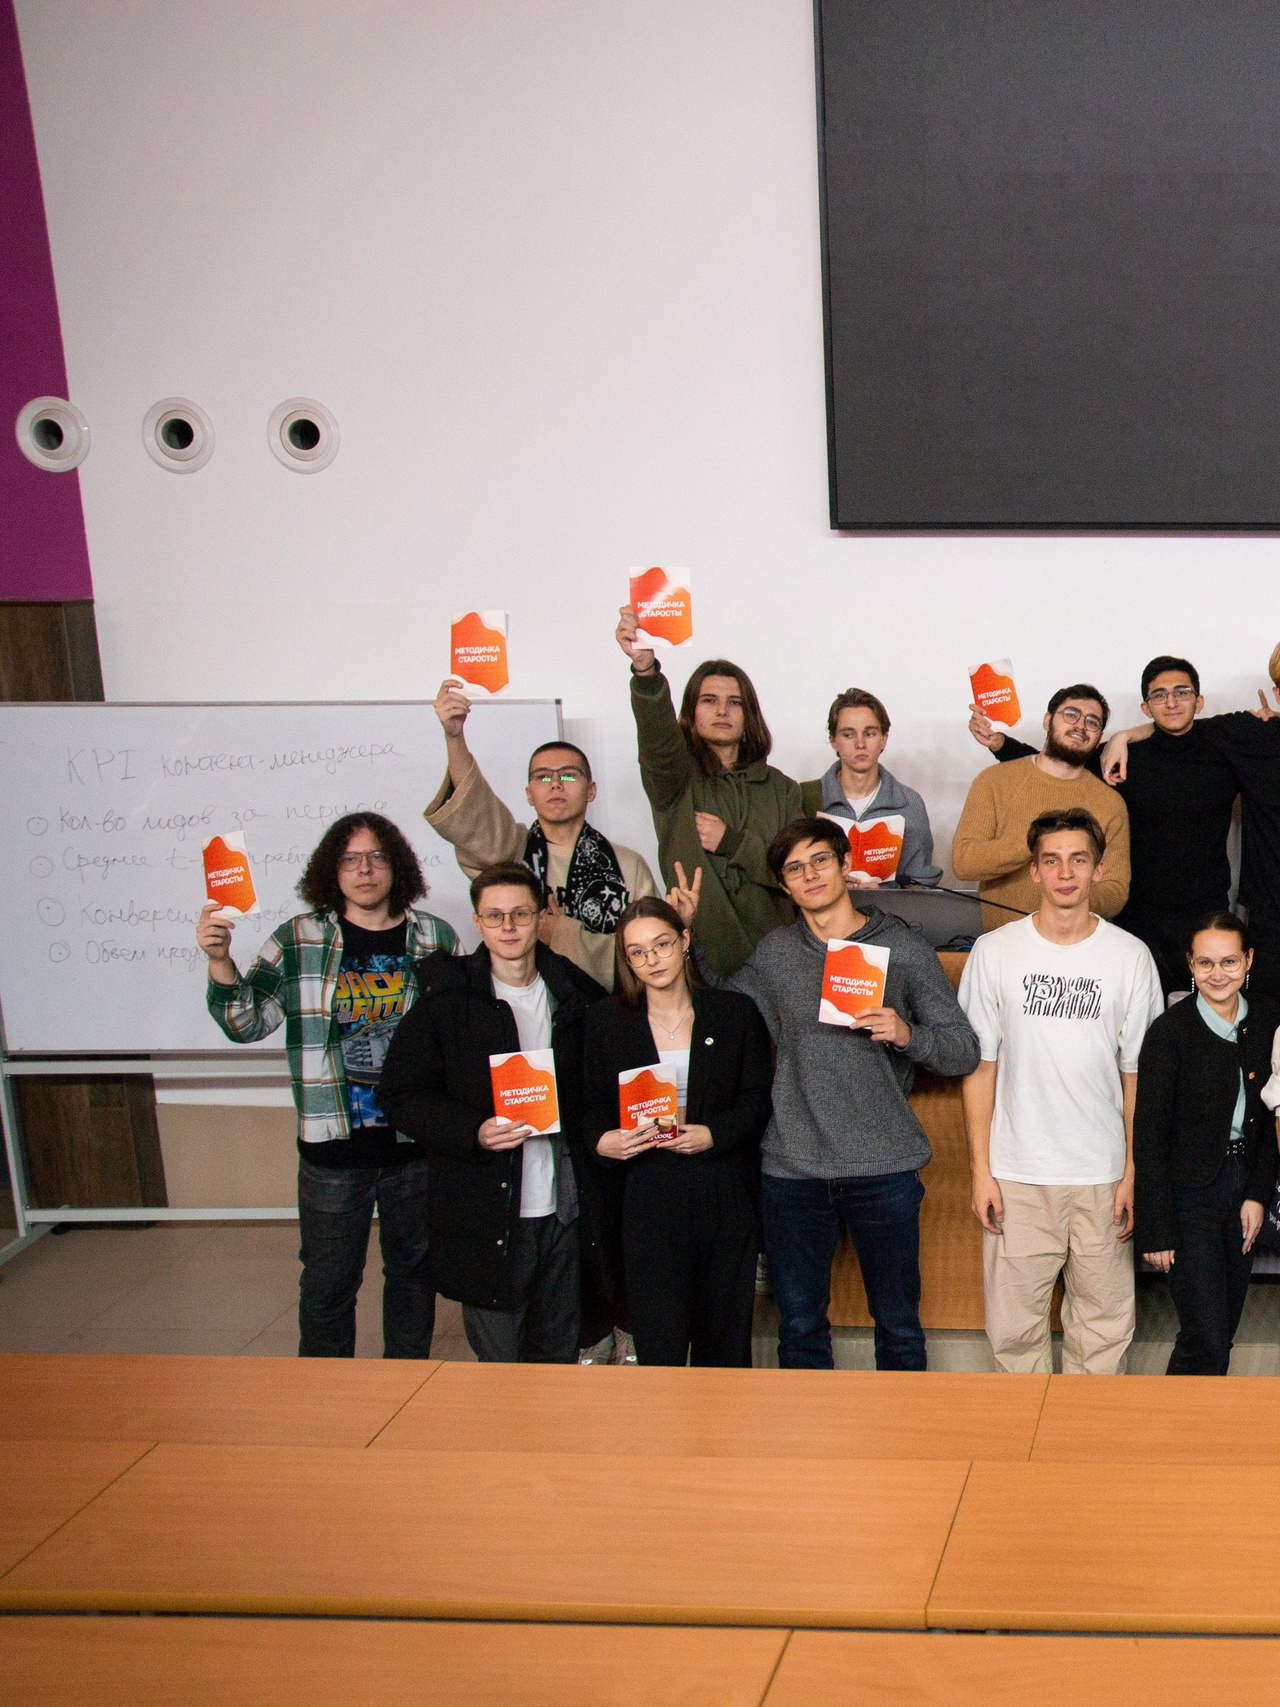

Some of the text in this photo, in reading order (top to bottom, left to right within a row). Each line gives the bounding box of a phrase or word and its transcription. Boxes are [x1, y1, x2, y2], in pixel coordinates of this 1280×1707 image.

[454, 645, 500, 655] МЕТОДИЧКА
[458, 654, 498, 663] СТАРОСТЫ
[977, 687, 1011, 700] МЕТОДИЧКА
[981, 695, 1011, 706] СТАРОСТЫ
[863, 845, 898, 856] МЕТОДИЧКА
[865, 853, 895, 862] СТАРОСТЫ
[207, 866, 245, 880] МЕТОДИЧКА
[210, 875, 244, 888] СТАРОСТЫ
[335, 971, 405, 998] BACK
[829, 975, 878, 988] МЕТОДИЧКА
[832, 984, 874, 996] СТАРОСТЫ
[499, 1084, 549, 1098] МЕТОДИЧКА
[504, 1094, 547, 1106] СТАРОСТЫ
[627, 1096, 671, 1112] МЕТОДИЧКА
[631, 1104, 669, 1119] СТАРОСТЫ
